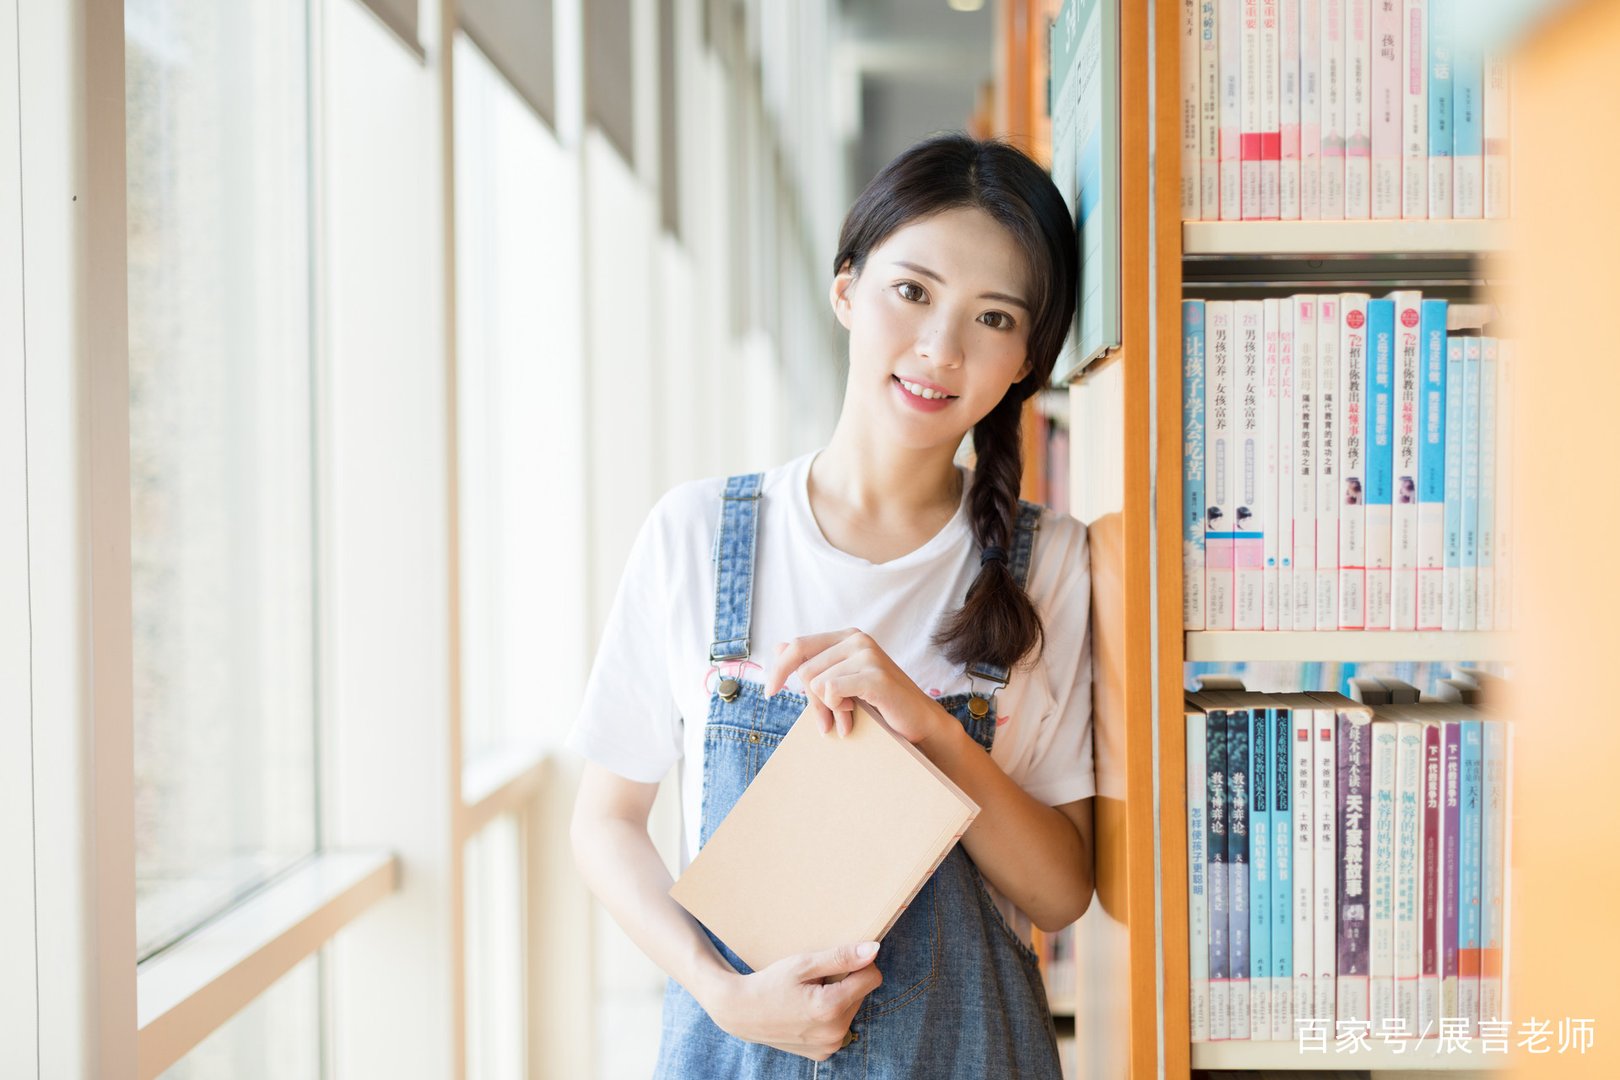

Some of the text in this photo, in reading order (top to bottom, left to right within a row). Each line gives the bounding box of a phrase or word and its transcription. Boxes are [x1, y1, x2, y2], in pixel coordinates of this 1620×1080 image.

[1184, 336, 1203, 481] 让孩子学会吃苦
[1211, 772, 1224, 834] 教子博弈论
[1231, 772, 1246, 834] 教子博弈论
